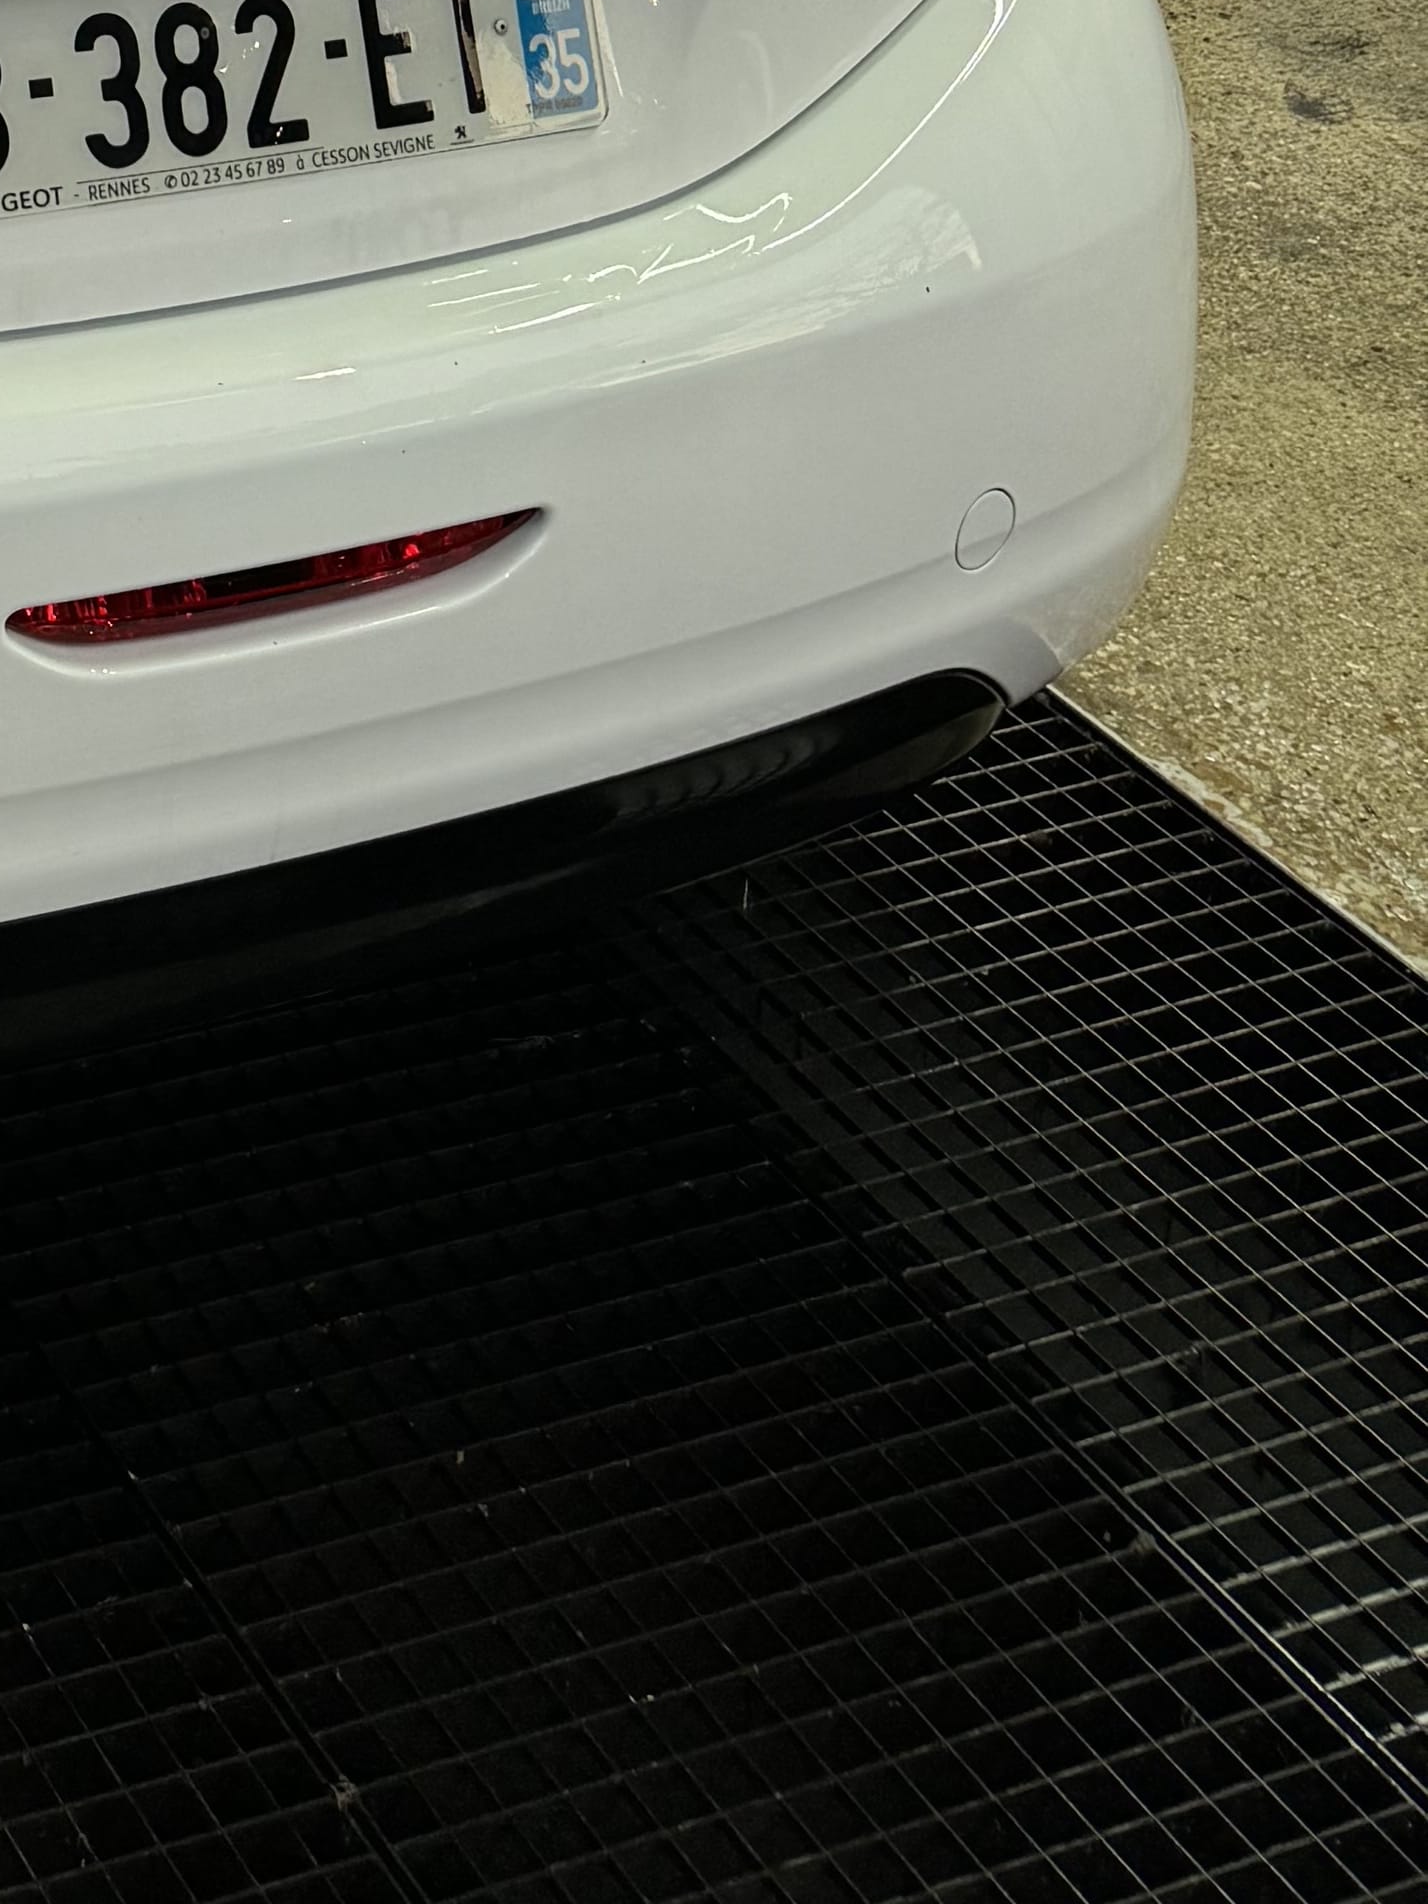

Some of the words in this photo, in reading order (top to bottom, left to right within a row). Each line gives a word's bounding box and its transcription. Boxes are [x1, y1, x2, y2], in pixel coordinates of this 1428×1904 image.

[529, 27, 589, 99] 35
[87, 177, 151, 202] RENNES
[180, 171, 199, 188] 02
[203, 167, 221, 185] 23
[224, 163, 243, 181] 45
[246, 160, 262, 178] 67
[267, 157, 285, 175] 89
[311, 146, 371, 169] CESSON
[373, 134, 436, 159] SEVIGNE
